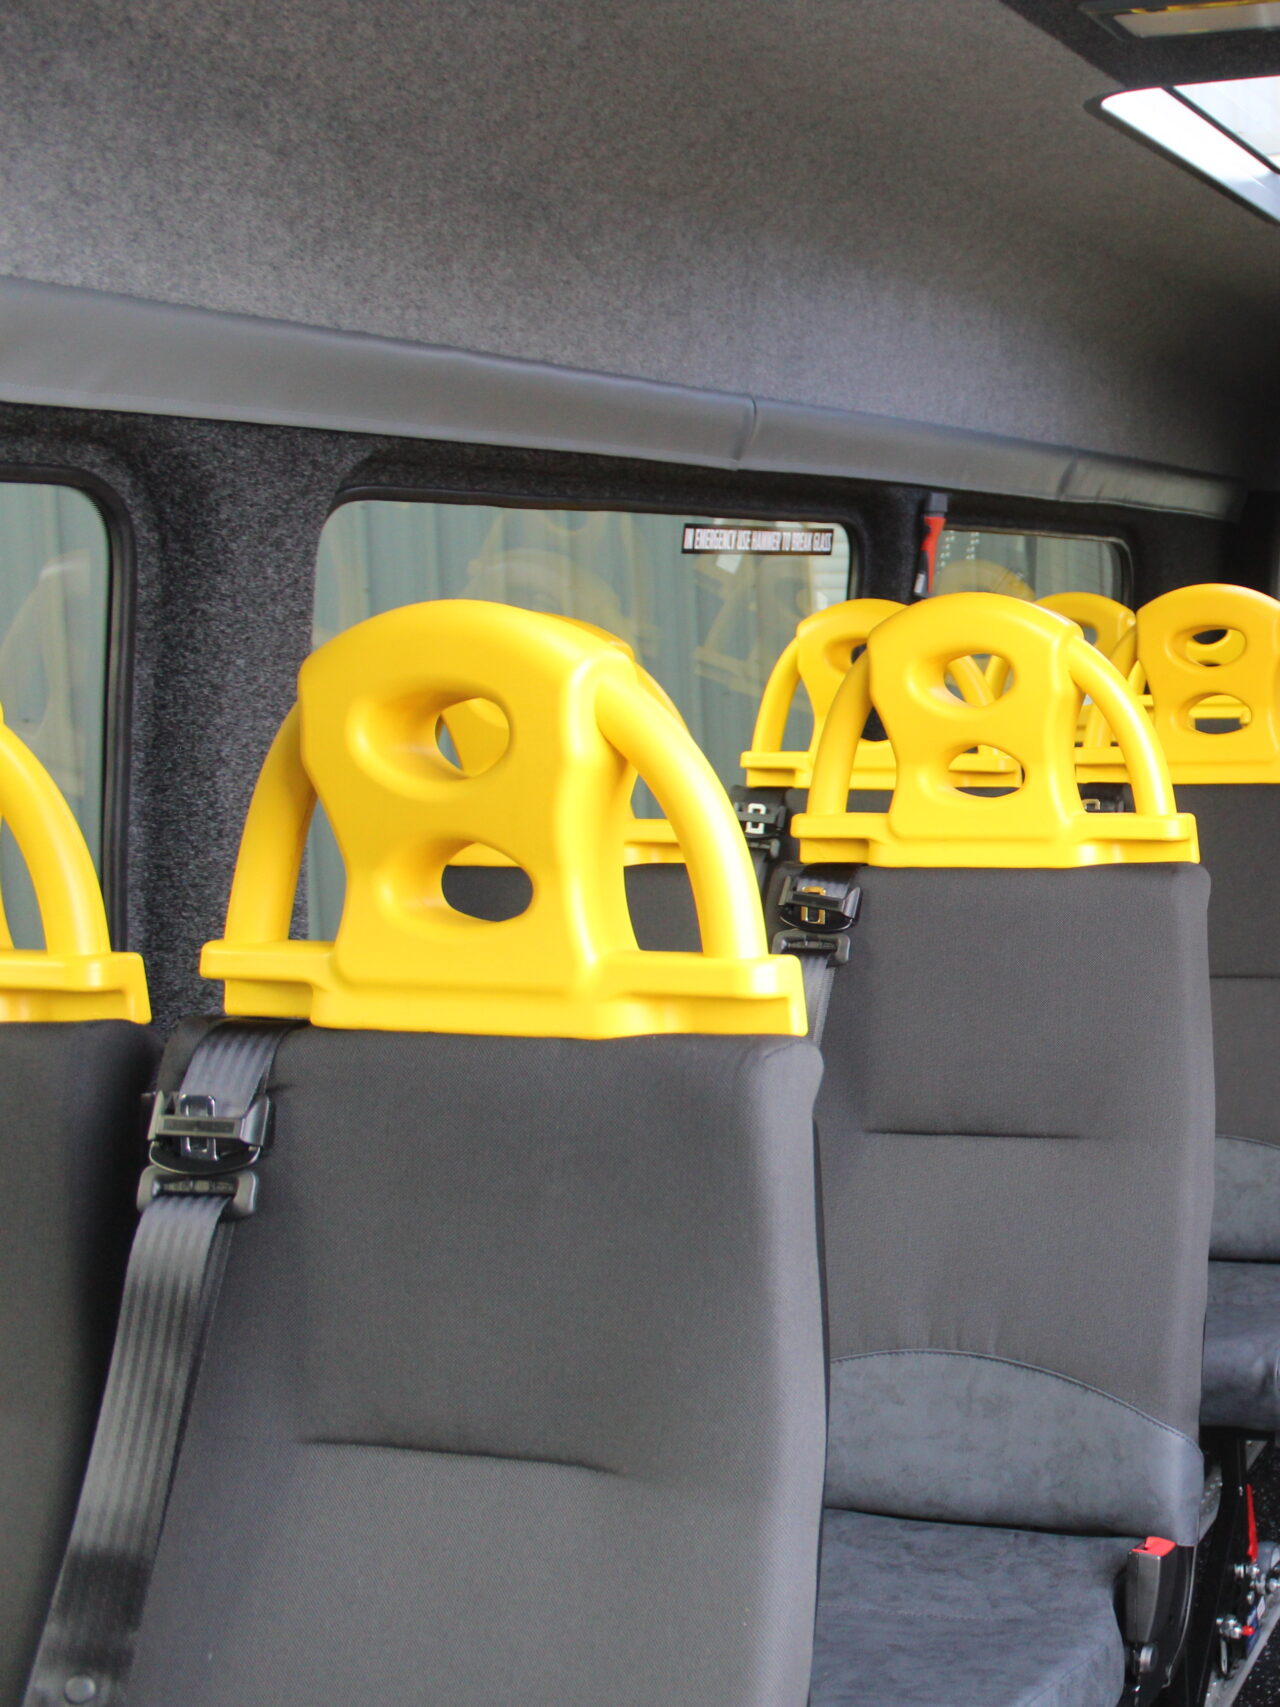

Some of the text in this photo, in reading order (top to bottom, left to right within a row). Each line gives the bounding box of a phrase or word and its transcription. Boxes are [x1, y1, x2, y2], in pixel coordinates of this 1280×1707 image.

[694, 528, 737, 550] EMERGENCY
[736, 530, 751, 551] USE
[751, 530, 781, 552] HAMMER
[782, 532, 792, 552] TO
[791, 532, 813, 552] BREAK
[812, 532, 832, 552] GLASS
